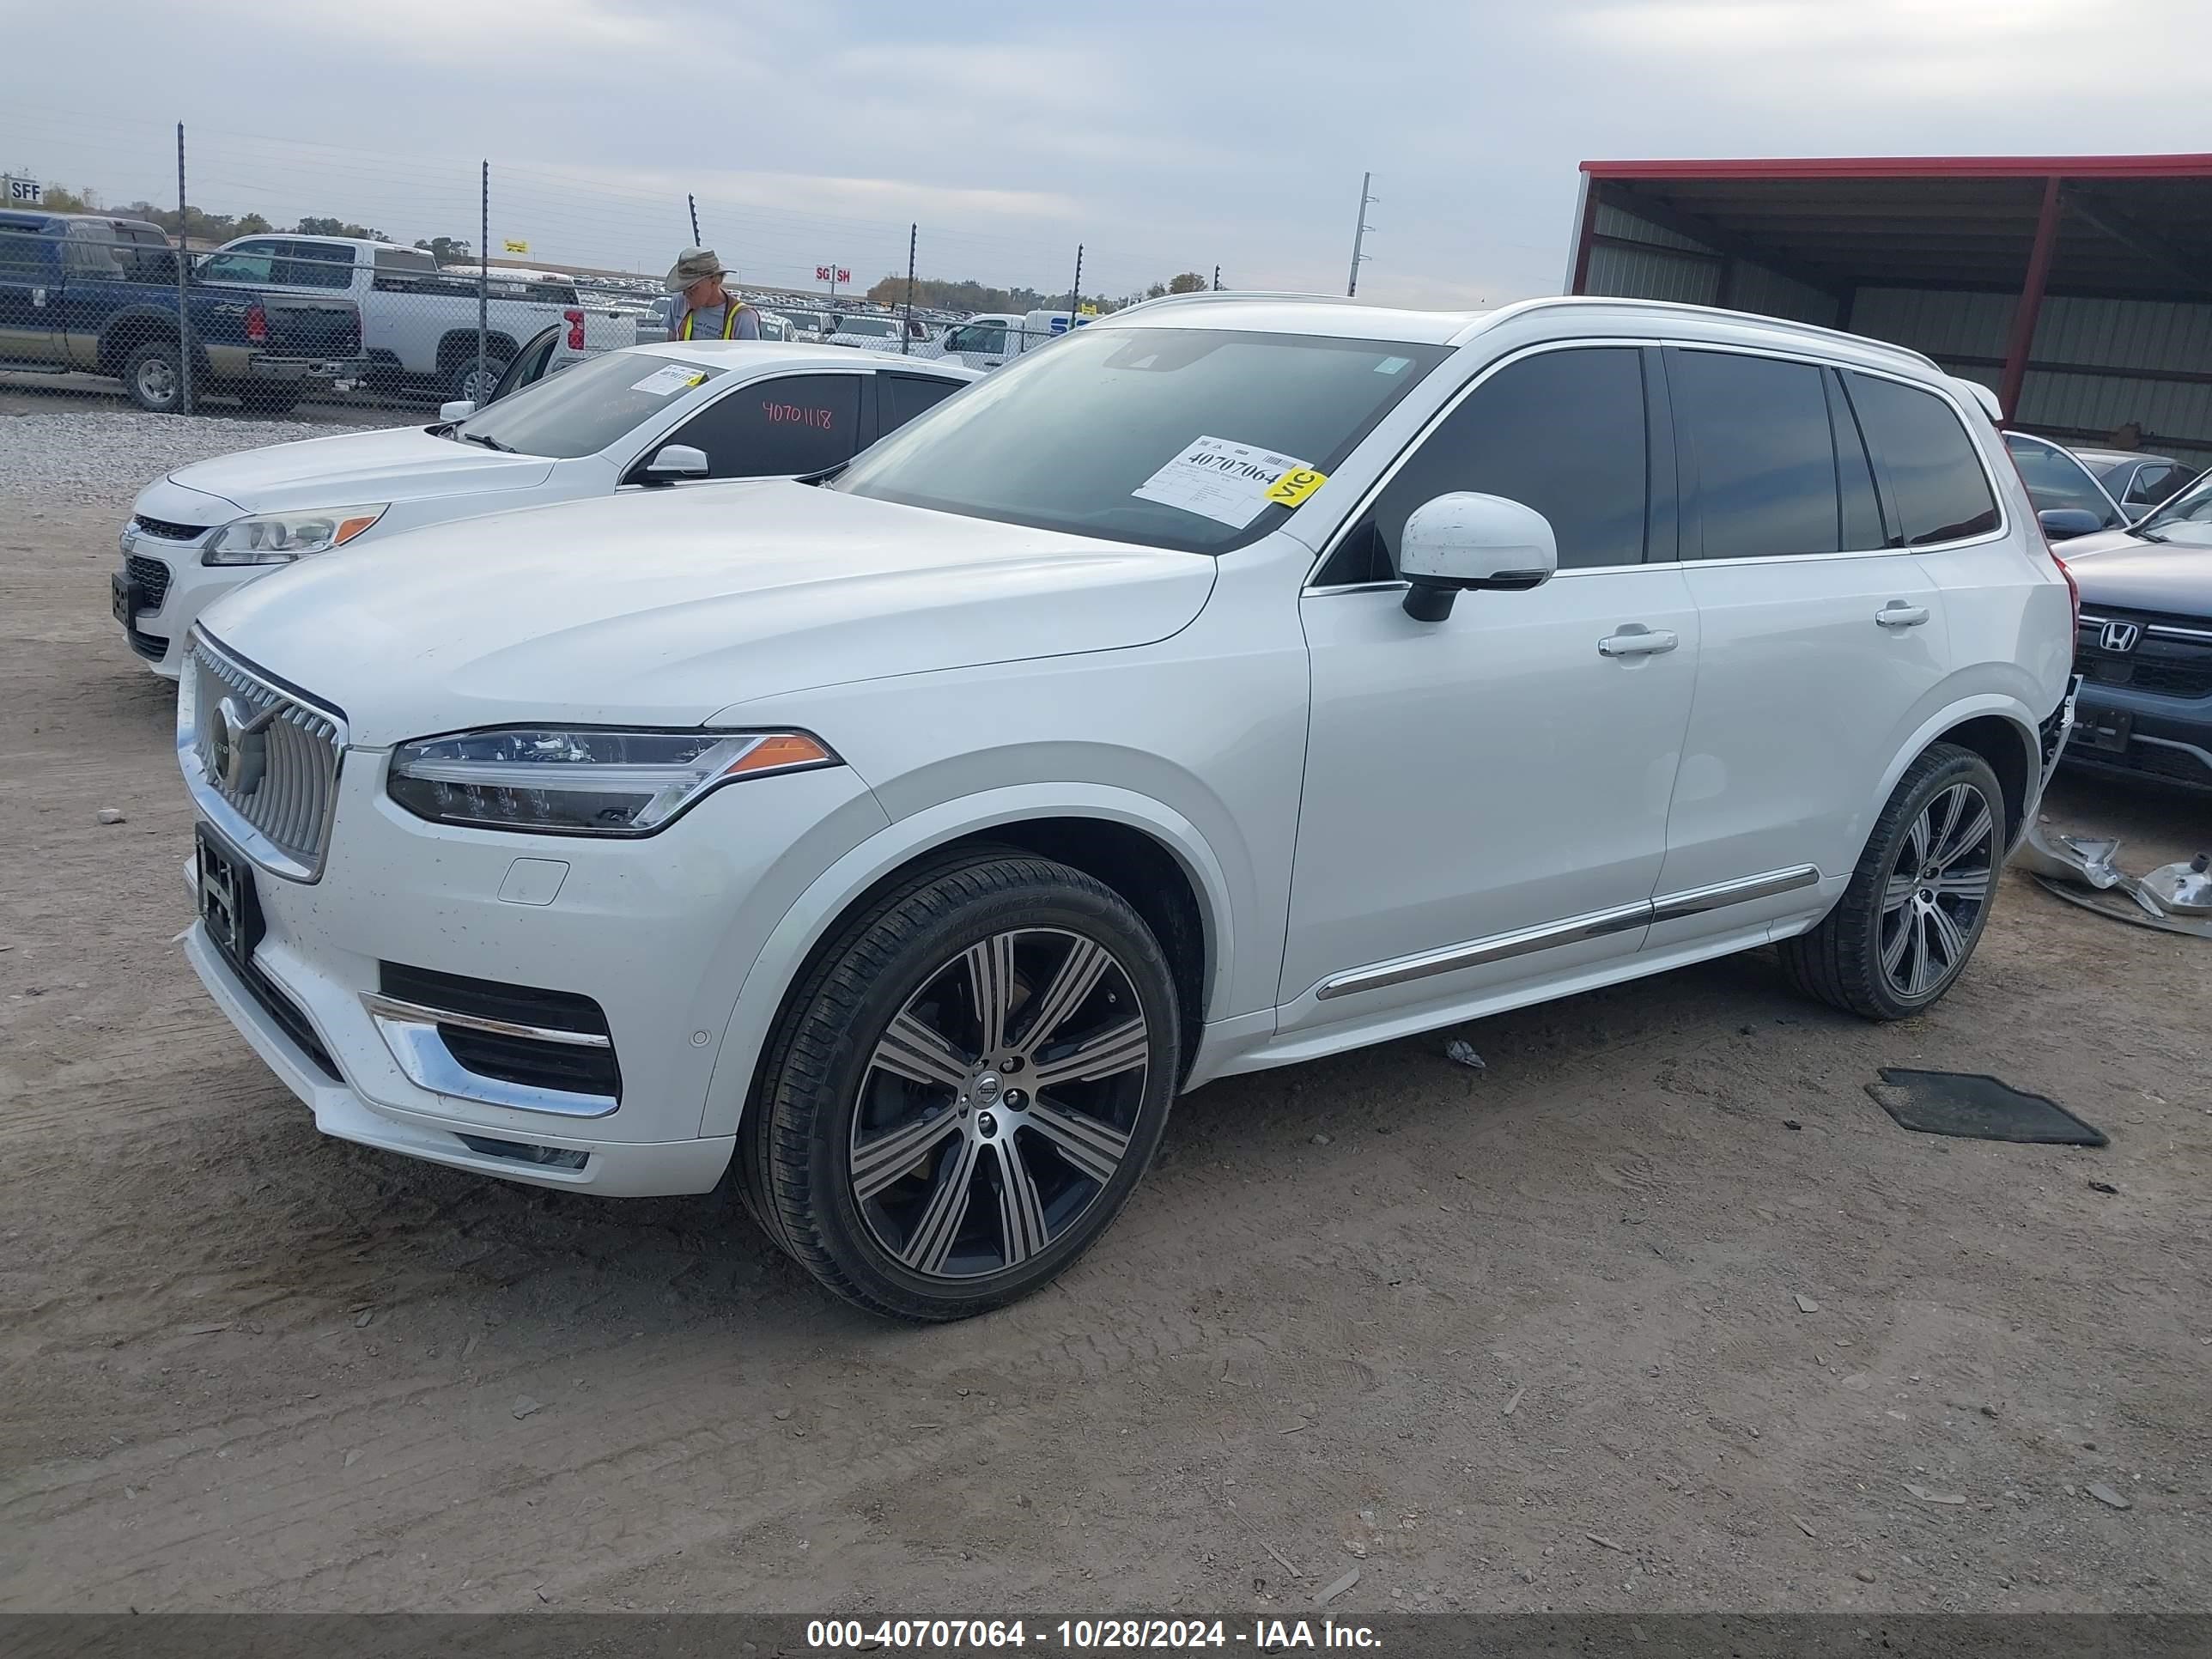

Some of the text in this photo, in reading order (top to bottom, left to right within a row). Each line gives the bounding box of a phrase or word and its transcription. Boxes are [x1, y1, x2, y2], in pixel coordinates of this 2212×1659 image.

[12, 182, 40, 200] SFF
[817, 267, 830, 280] SG
[837, 270, 850, 283] SH
[763, 400, 832, 429] 40701118
[1188, 452, 1282, 485] 40707064
[1273, 472, 1316, 498] VIC
